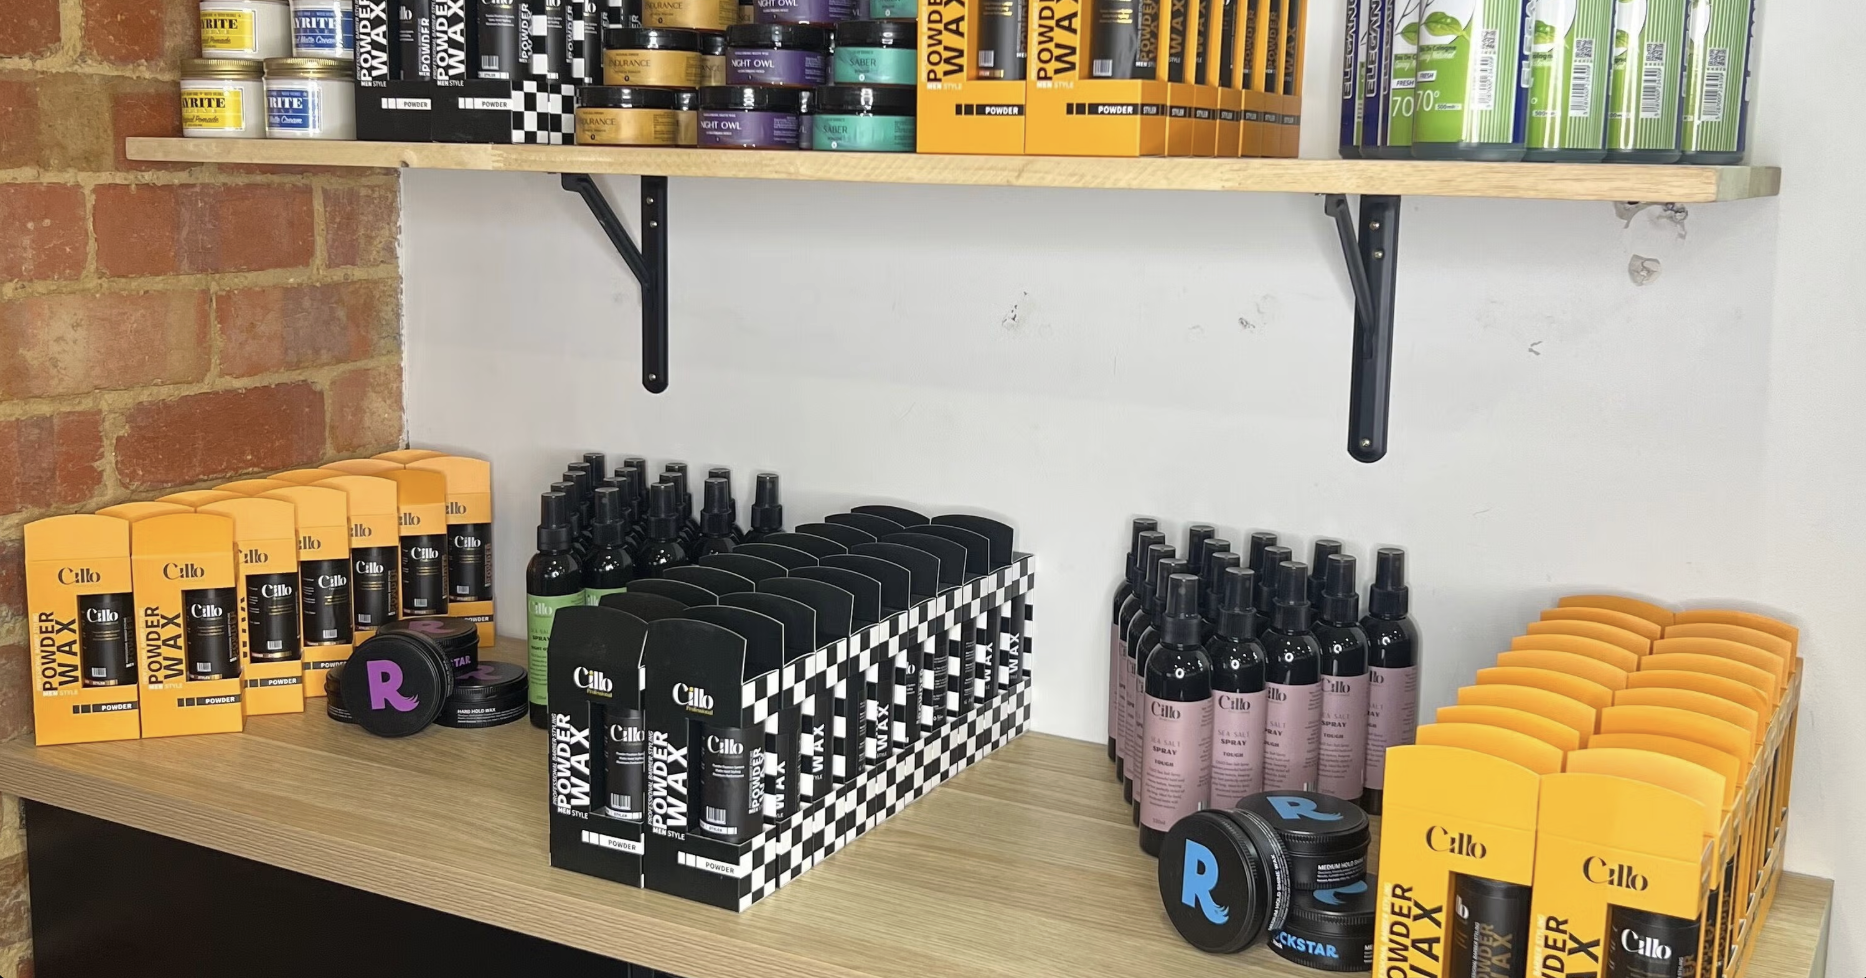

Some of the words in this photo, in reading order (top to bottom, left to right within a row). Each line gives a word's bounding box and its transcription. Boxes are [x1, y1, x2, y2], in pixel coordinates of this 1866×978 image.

[400, 5, 413, 20] llo
[520, 3, 529, 59] POWDER
[1169, 0, 1185, 54] WAX
[370, 0, 388, 77] WAX
[422, 18, 431, 71] POWDER
[435, 0, 450, 81] POWDE
[447, 0, 466, 77] WAX
[753, 59, 775, 69] OWL
[850, 58, 877, 67] SABER
[373, 80, 387, 88] STYLE
[1396, 79, 1415, 87] FRESH
[267, 97, 303, 109] RITE
[984, 106, 1019, 115] POWDER
[1098, 105, 1134, 114] POWDER
[1143, 106, 1158, 115] STYLER
[1171, 108, 1185, 117] STYLER
[1196, 110, 1209, 119] STYLER
[1221, 111, 1234, 120] STYLER
[721, 121, 742, 130] OWL
[823, 125, 848, 134] SABER
[299, 536, 321, 551] illo
[454, 535, 482, 550] Cillo
[411, 547, 439, 561] Cillo
[58, 566, 101, 585] Cillo
[163, 562, 206, 581] Cillo
[356, 560, 384, 576] Cillo
[318, 575, 347, 590] Cillo
[261, 584, 293, 599] Cillo
[87, 607, 119, 623] Cillo
[191, 603, 223, 621] Cillo
[38, 611, 59, 692] POWDER
[54, 618, 80, 687] WAX
[145, 606, 164, 684] POWDER
[160, 612, 184, 680] WAX
[1008, 632, 1020, 673] WAX
[985, 641, 994, 682] WAX
[268, 678, 298, 687] POWDER
[573, 666, 613, 693] Cillo
[1370, 669, 1384, 684] llo
[1321, 677, 1351, 693] Cillo
[205, 696, 236, 705] POWDER
[672, 682, 714, 710] Cillo
[1267, 686, 1287, 702] illo
[102, 703, 132, 711] POWDER
[1151, 700, 1181, 720] Cillo
[1218, 694, 1251, 712] Cillo
[1334, 712, 1350, 720] SALT
[877, 703, 890, 751] WAX
[1272, 721, 1287, 729] SALT
[1321, 720, 1347, 729] SPRAY
[610, 723, 646, 743] Cillo
[1217, 729, 1231, 737] SEA
[1233, 730, 1250, 738] SALT
[707, 734, 744, 755] Cillo
[812, 723, 825, 773] WAX
[1152, 745, 1178, 756] SPRAY
[1163, 739, 1181, 748] SALT
[1220, 738, 1247, 747] SPRAY
[556, 713, 572, 810] POWDER
[570, 725, 590, 806] WAX
[1154, 759, 1174, 767] TOUGH
[653, 730, 669, 830] POWDER
[666, 742, 688, 827] WAX
[751, 746, 762, 808] POWDER
[557, 806, 571, 816] MEN
[572, 809, 589, 820] STYLE
[652, 826, 667, 836] MEN
[667, 830, 686, 841] STYLE
[608, 839, 637, 851] POWDER
[1425, 825, 1487, 859] Cillo
[706, 860, 735, 875] POWDER
[1270, 853, 1279, 870] WAX
[1583, 855, 1649, 892] Cillo
[1386, 882, 1413, 978] OWDER
[1621, 928, 1672, 960] Cillo
